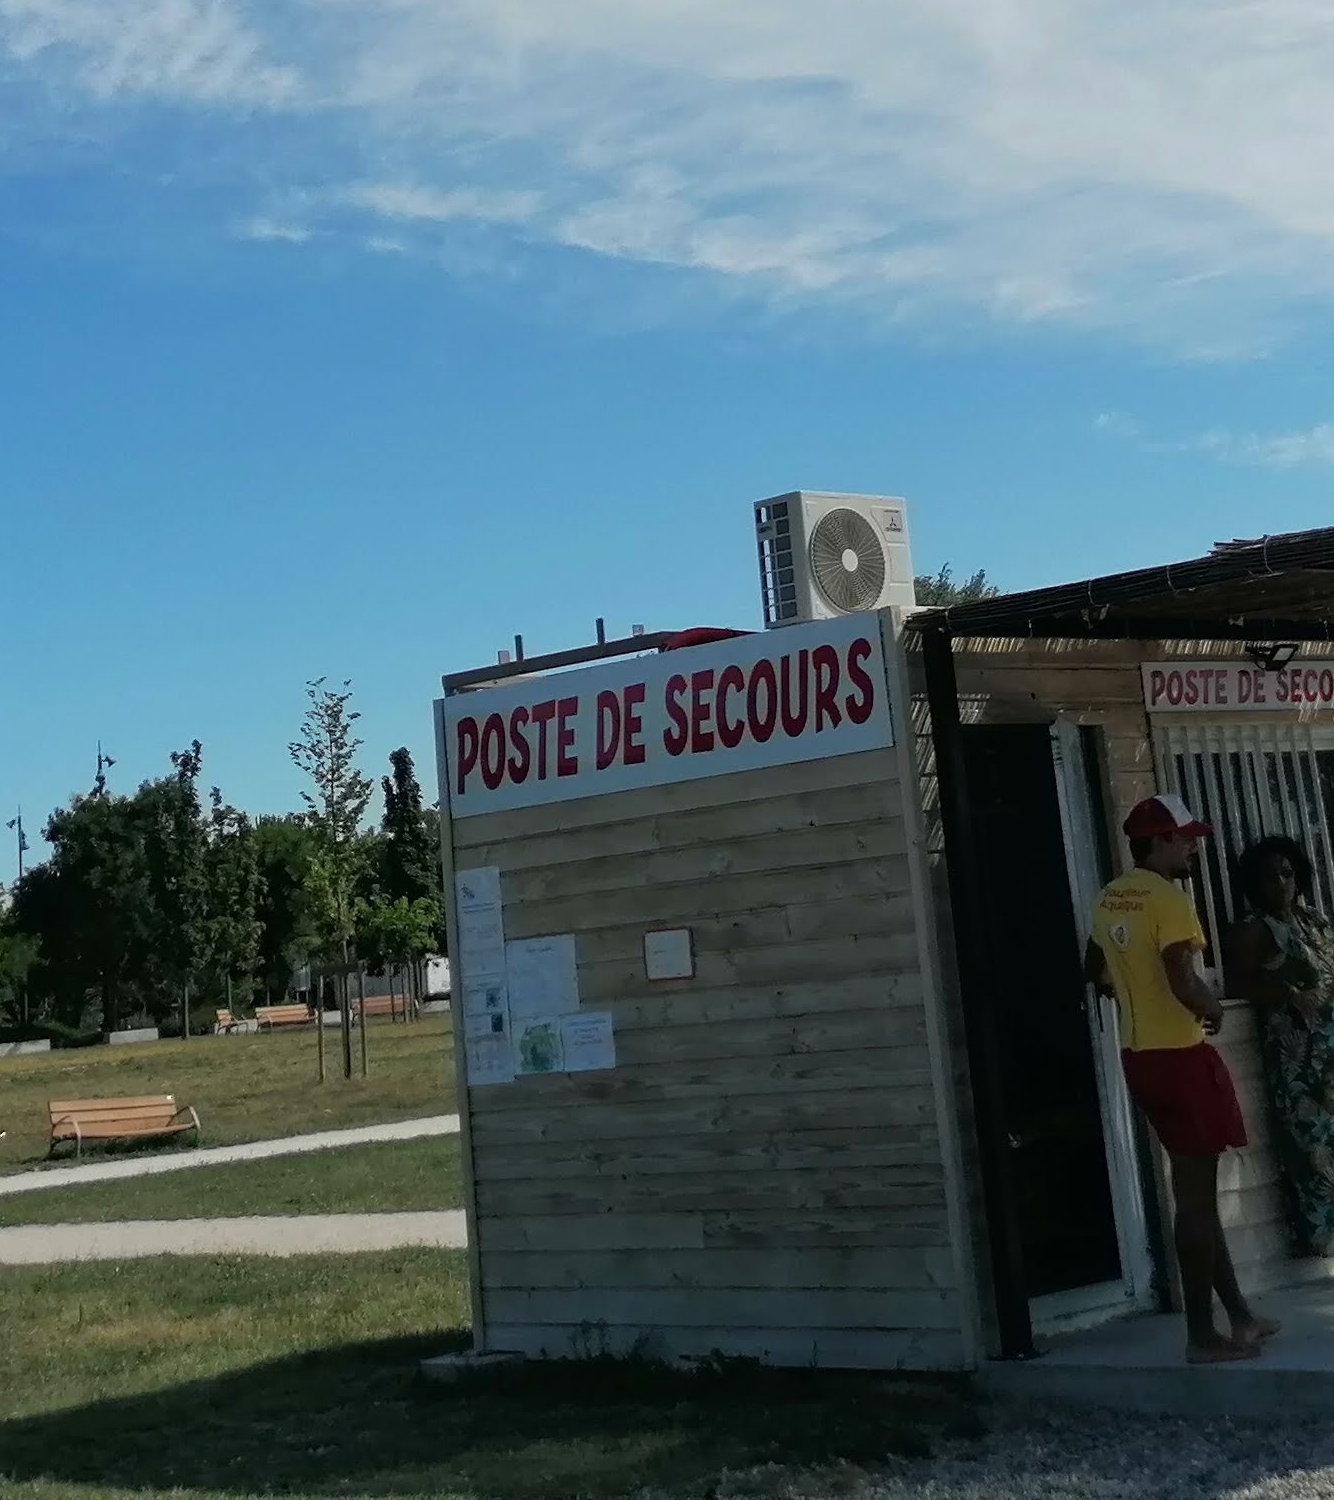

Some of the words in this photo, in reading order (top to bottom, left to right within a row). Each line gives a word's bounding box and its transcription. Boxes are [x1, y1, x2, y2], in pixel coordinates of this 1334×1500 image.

[457, 696, 578, 794] POSTE
[596, 683, 645, 770] DE
[663, 638, 874, 756] SECOURS
[1150, 670, 1227, 706] POSTE
[1238, 669, 1266, 704] DE
